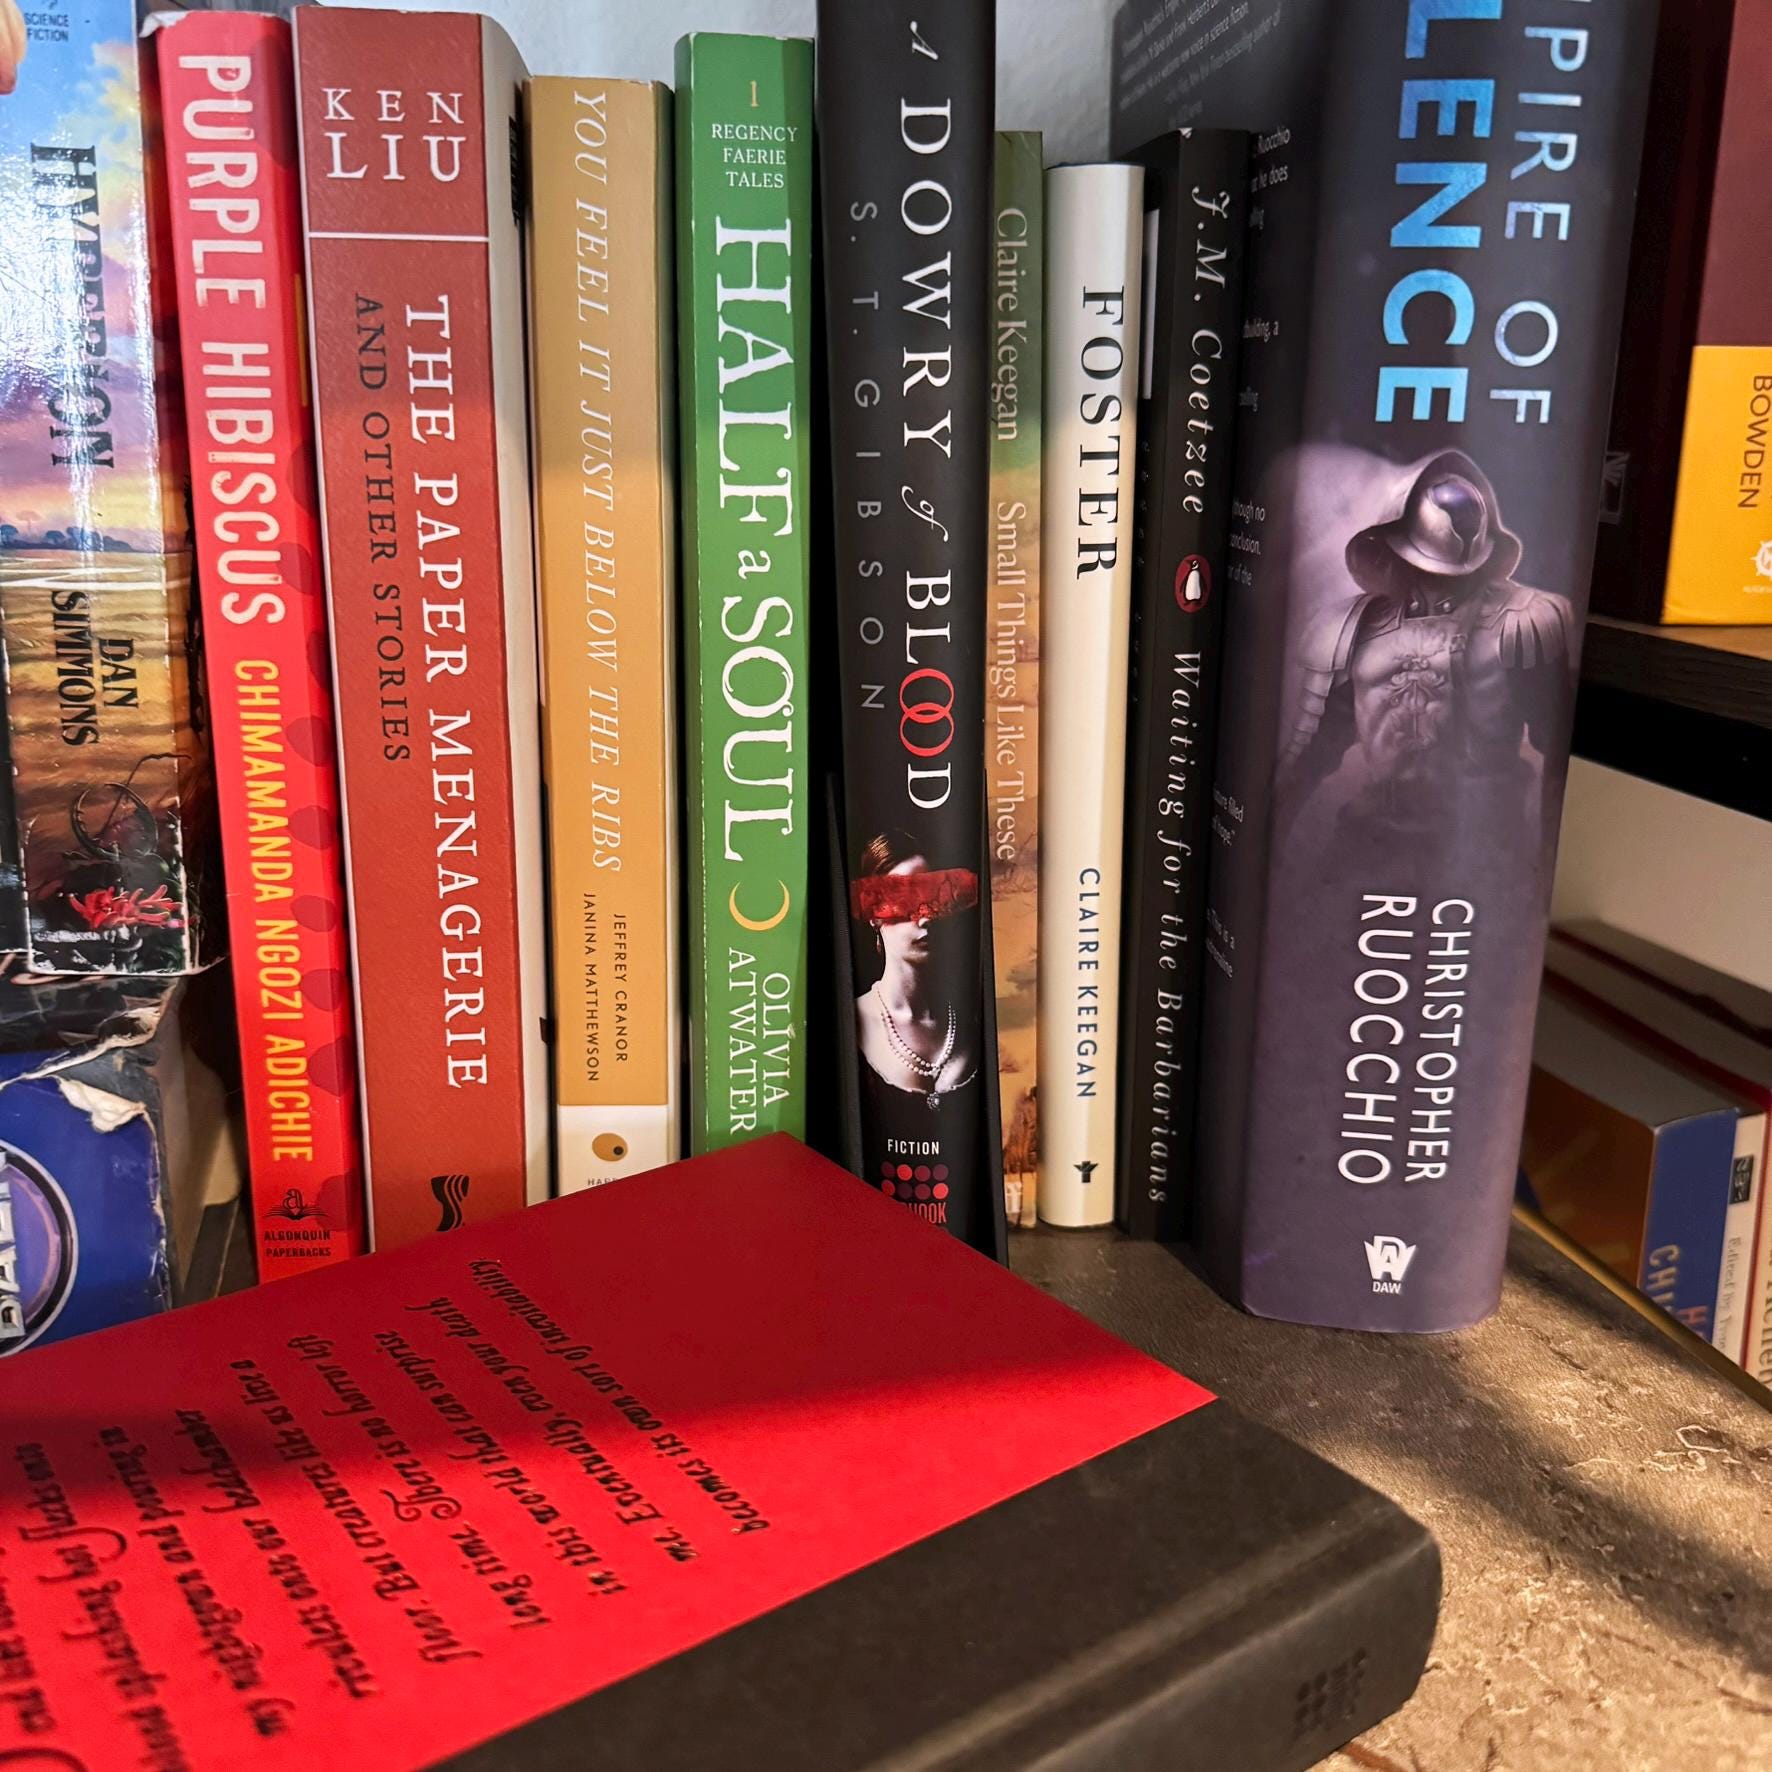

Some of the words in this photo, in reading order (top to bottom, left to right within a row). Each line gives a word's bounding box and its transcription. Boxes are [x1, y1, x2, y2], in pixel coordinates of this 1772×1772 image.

[24, 12, 70, 28] SCIENCE
[26, 27, 69, 42] FICTION
[909, 20, 939, 61] A
[322, 87, 466, 126] KEN
[748, 80, 760, 109] 1
[1505, 0, 1592, 242] PIRE
[326, 132, 467, 183] LIU
[573, 90, 608, 187] YOU
[711, 123, 799, 144] REGENCY
[722, 147, 787, 166] FAERIE
[178, 55, 266, 309] PURPLE
[725, 170, 785, 190] TALES
[574, 197, 609, 323] FEEL
[901, 97, 952, 458] DOWRY
[995, 207, 1029, 313] Claire
[353, 293, 389, 391] AND
[405, 294, 457, 445] THE
[578, 338, 612, 394] IT
[715, 214, 795, 537] HALF
[1490, 300, 1559, 424] OF
[992, 318, 1029, 442] Keegan
[579, 399, 615, 512] JUST
[1076, 285, 1125, 582] FOSTER
[1182, 327, 1224, 516] Coetzee
[1737, 375, 1772, 509] BOWDEN
[201, 341, 286, 625] HIBISCUS
[362, 411, 399, 563] OTHER
[901, 485, 949, 542] of
[414, 472, 469, 684] PAPER
[737, 548, 772, 580] a
[854, 378, 887, 710] GIBSON
[996, 501, 1027, 586] Small
[583, 522, 620, 671] BELOW
[51, 589, 100, 747] SIMMONS
[99, 637, 139, 710] DAN
[372, 582, 411, 763] STORIES
[989, 593, 1027, 699] Things
[899, 569, 955, 809] BLOOD
[587, 685, 622, 767] THE
[720, 595, 794, 863] SOUL
[996, 705, 1025, 766] Like
[1157, 650, 1201, 818] Waiting
[233, 658, 294, 905] CHIMAMANDA
[996, 770, 1025, 862] These
[591, 782, 623, 873] RIBS
[1157, 829, 1193, 895] for
[428, 708, 489, 1089] MENAGERIE
[582, 892, 598, 963] JANINA
[1076, 867, 1101, 972] CLAIRE
[255, 918, 304, 1021] NGOZI
[613, 912, 628, 987] JEFFREY
[1157, 908, 1189, 971] the
[584, 964, 600, 1083] MATTHEWSON
[615, 988, 629, 1064] CRANOR
[728, 946, 759, 1136] ATWATER
[761, 971, 791, 1106] OLIVIA
[1075, 984, 1100, 1098] KEEGAN
[1337, 894, 1417, 1184] RUOCCHIO
[1404, 897, 1474, 1183] CHRISTOPHER
[263, 1032, 314, 1163] ADICHIE
[1148, 988, 1185, 1203] Barbarians
[887, 1138, 940, 1156] FICTION
[264, 1230, 331, 1241] ALGONQUIN
[265, 1247, 332, 1258] PAPERBACKS
[404, 1296, 482, 1338] death
[1372, 1281, 1402, 1295] DAW
[229, 1359, 256, 1371] a
[287, 1334, 334, 1362] left
[374, 1331, 445, 1392] surprise
[467, 1342, 530, 1375] your
[545, 1345, 593, 1362] of
[572, 1362, 624, 1394] sort
[239, 1372, 281, 1406] live
[261, 1404, 295, 1426] us
[317, 1363, 375, 1417] horror
[430, 1393, 474, 1423] can
[503, 1375, 553, 1413] even
[611, 1395, 663, 1432] own
[175, 1408, 262, 1514] bedchamber
[274, 1427, 321, 1462] like
[360, 1416, 396, 1438] no
[374, 1440, 411, 1460] is
[447, 1425, 510, 1465] that
[651, 1432, 691, 1459] its
[107, 1443, 186, 1522] pouring
[379, 1459, 462, 1523] There
[484, 1466, 560, 1525] world
[544, 1411, 664, 1526] Eventually,
[676, 1457, 771, 1535] becomes
[242, 1518, 287, 1550] our
[303, 1462, 387, 1550] creatures
[137, 1524, 195, 1564] and
[267, 1553, 318, 1601] onto
[363, 1552, 421, 1601] But
[449, 1521, 509, 1576] time.
[547, 1526, 602, 1567] this
[654, 1526, 698, 1563] me.
[489, 1574, 550, 1629] long
[587, 1570, 627, 1596] in
[297, 1603, 379, 1699] rivulets
[405, 1599, 484, 1664] floor.
